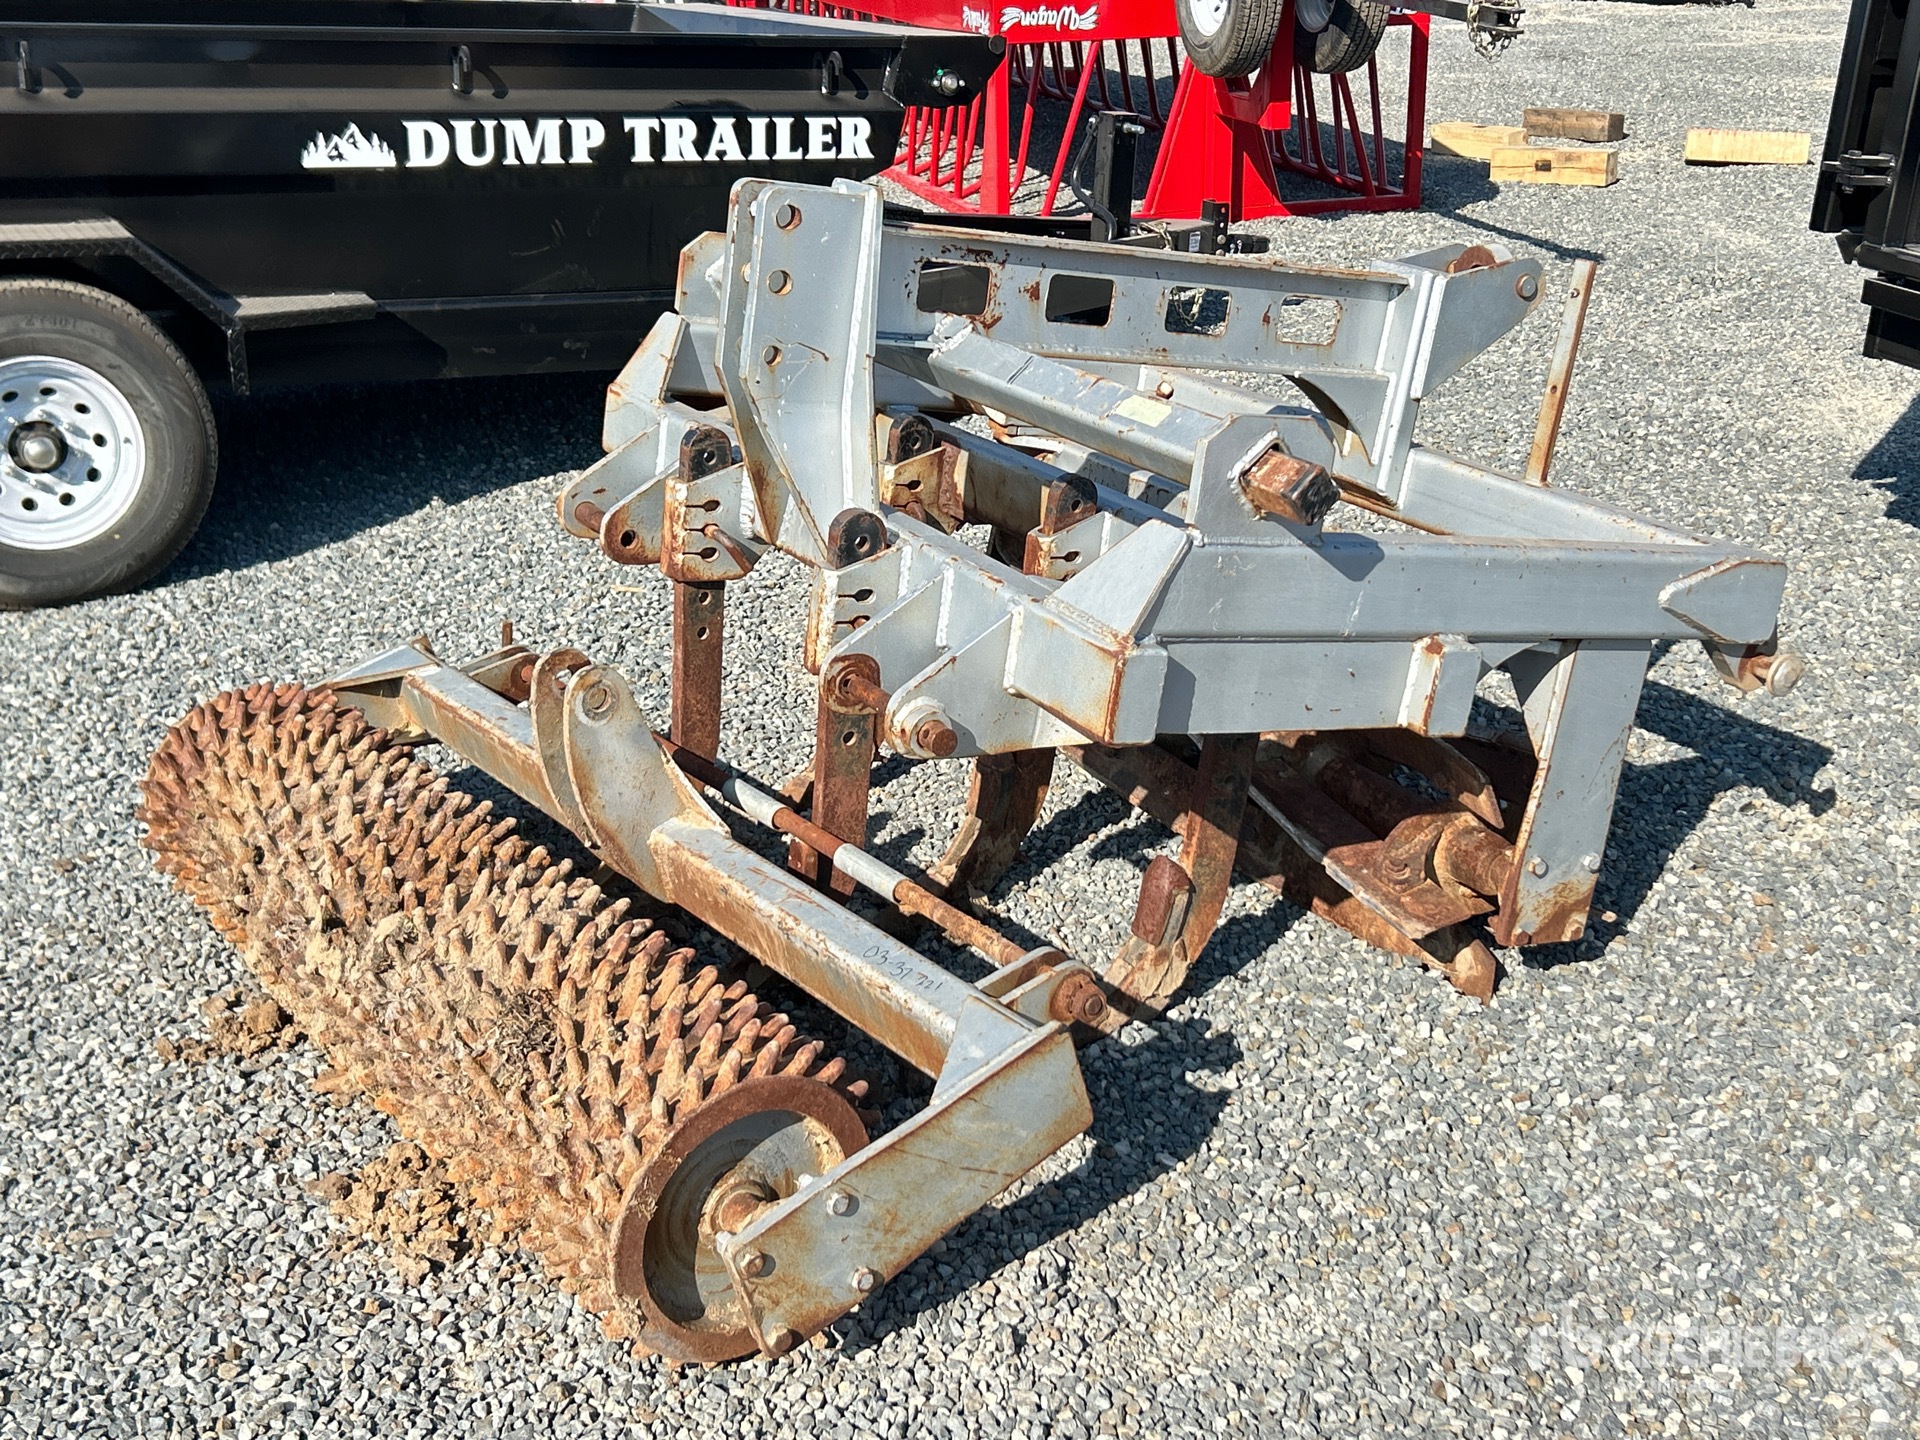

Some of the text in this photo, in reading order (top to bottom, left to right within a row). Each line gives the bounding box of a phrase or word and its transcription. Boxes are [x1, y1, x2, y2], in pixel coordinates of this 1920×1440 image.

[1019, 5, 1081, 32] Wagon
[402, 115, 875, 168] DUMP TRAILER
